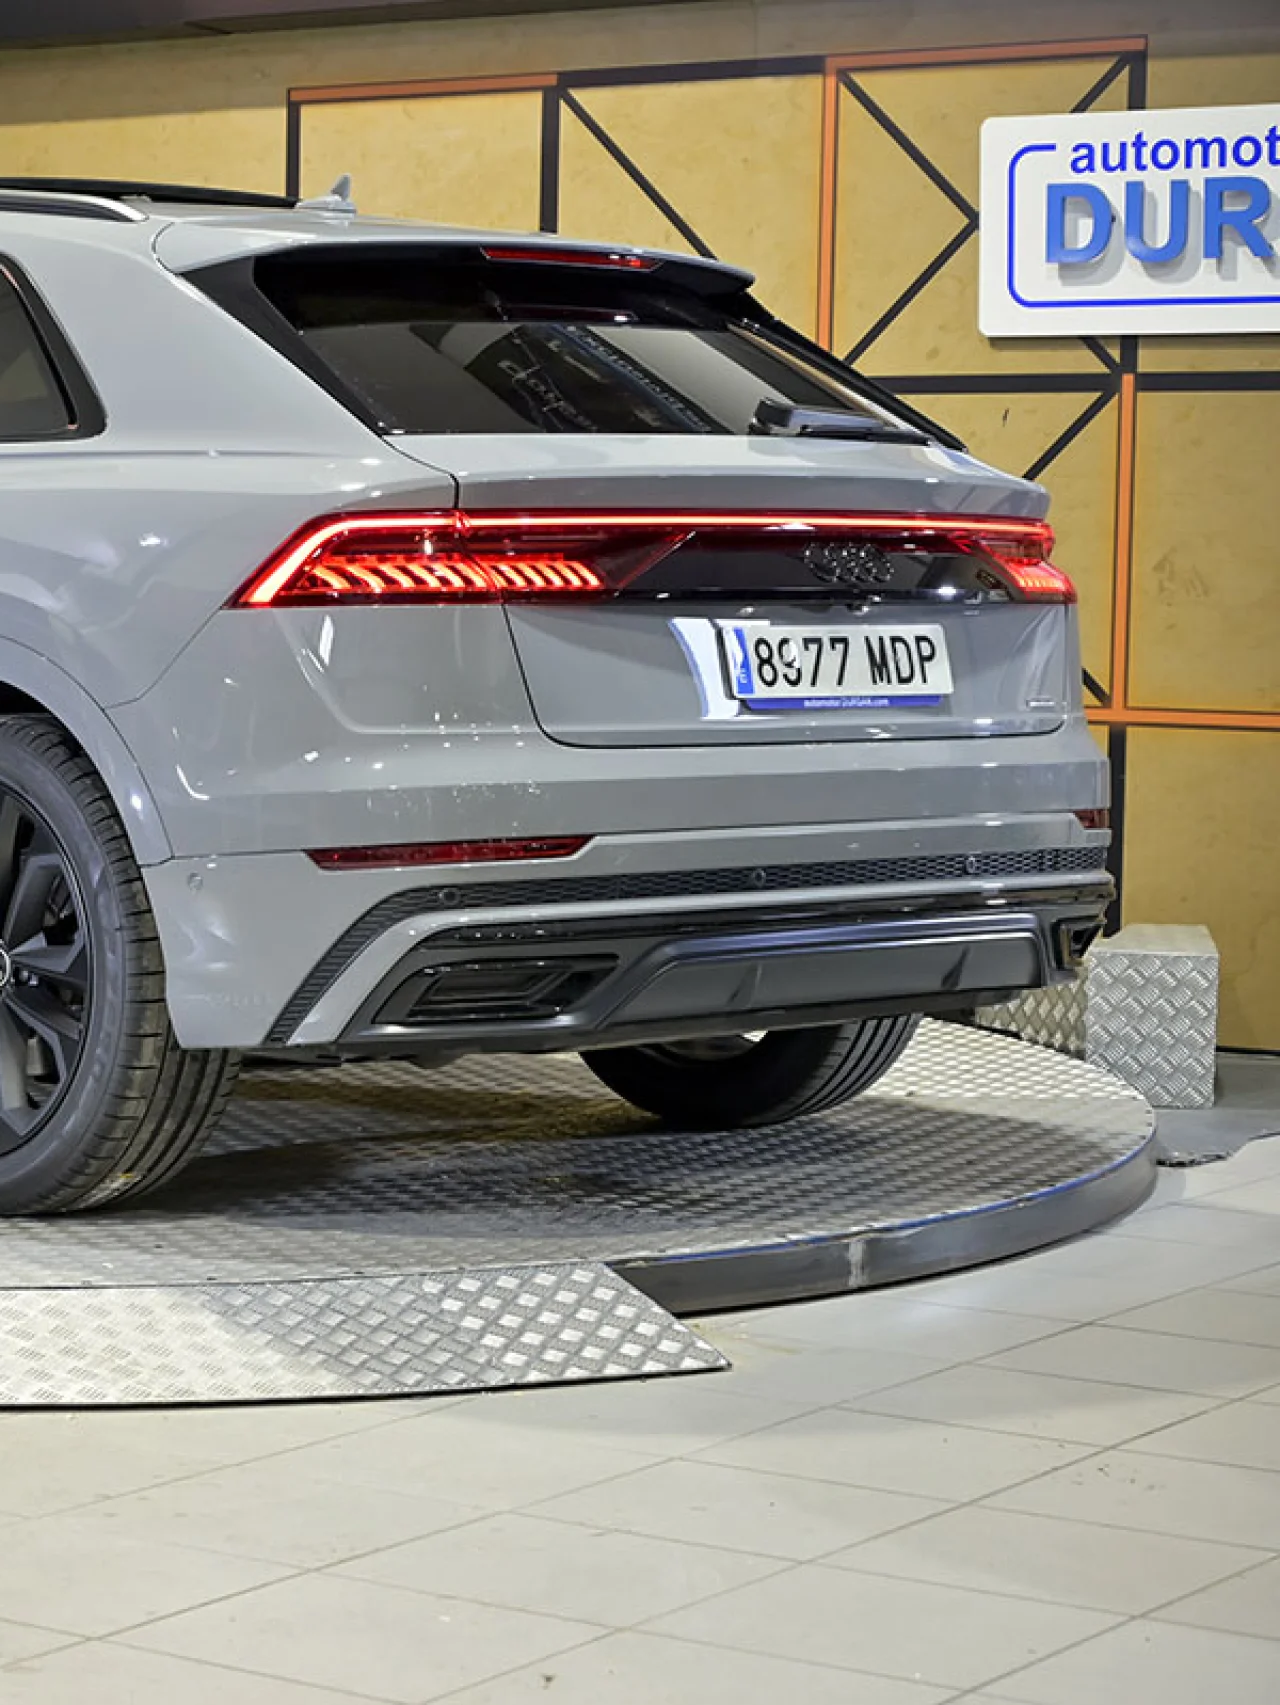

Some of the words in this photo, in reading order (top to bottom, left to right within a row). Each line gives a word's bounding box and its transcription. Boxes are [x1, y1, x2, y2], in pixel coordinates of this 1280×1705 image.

[1045, 176, 1275, 263] DUR
[754, 637, 849, 687] 8977
[864, 635, 936, 685] MDP
